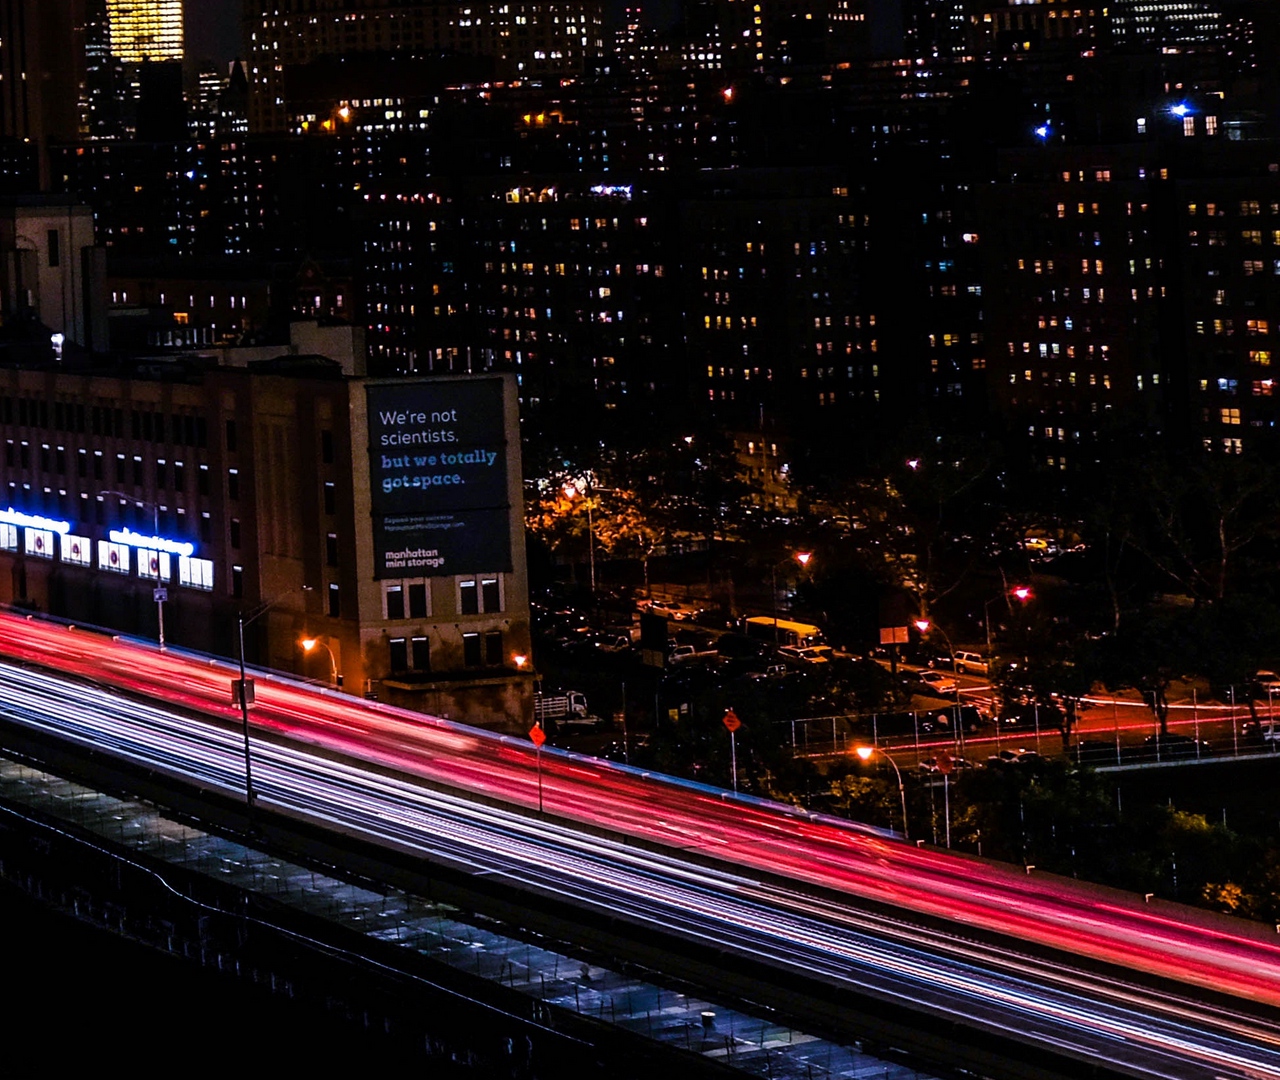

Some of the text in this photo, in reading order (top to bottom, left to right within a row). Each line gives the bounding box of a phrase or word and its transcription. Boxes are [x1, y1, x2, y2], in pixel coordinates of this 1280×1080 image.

[379, 408, 458, 425] We're not
[380, 429, 459, 446] scientists.
[381, 449, 498, 469] but we totally
[382, 473, 465, 494] got space.
[385, 546, 439, 560] manhattan
[385, 556, 445, 569] mini storage
